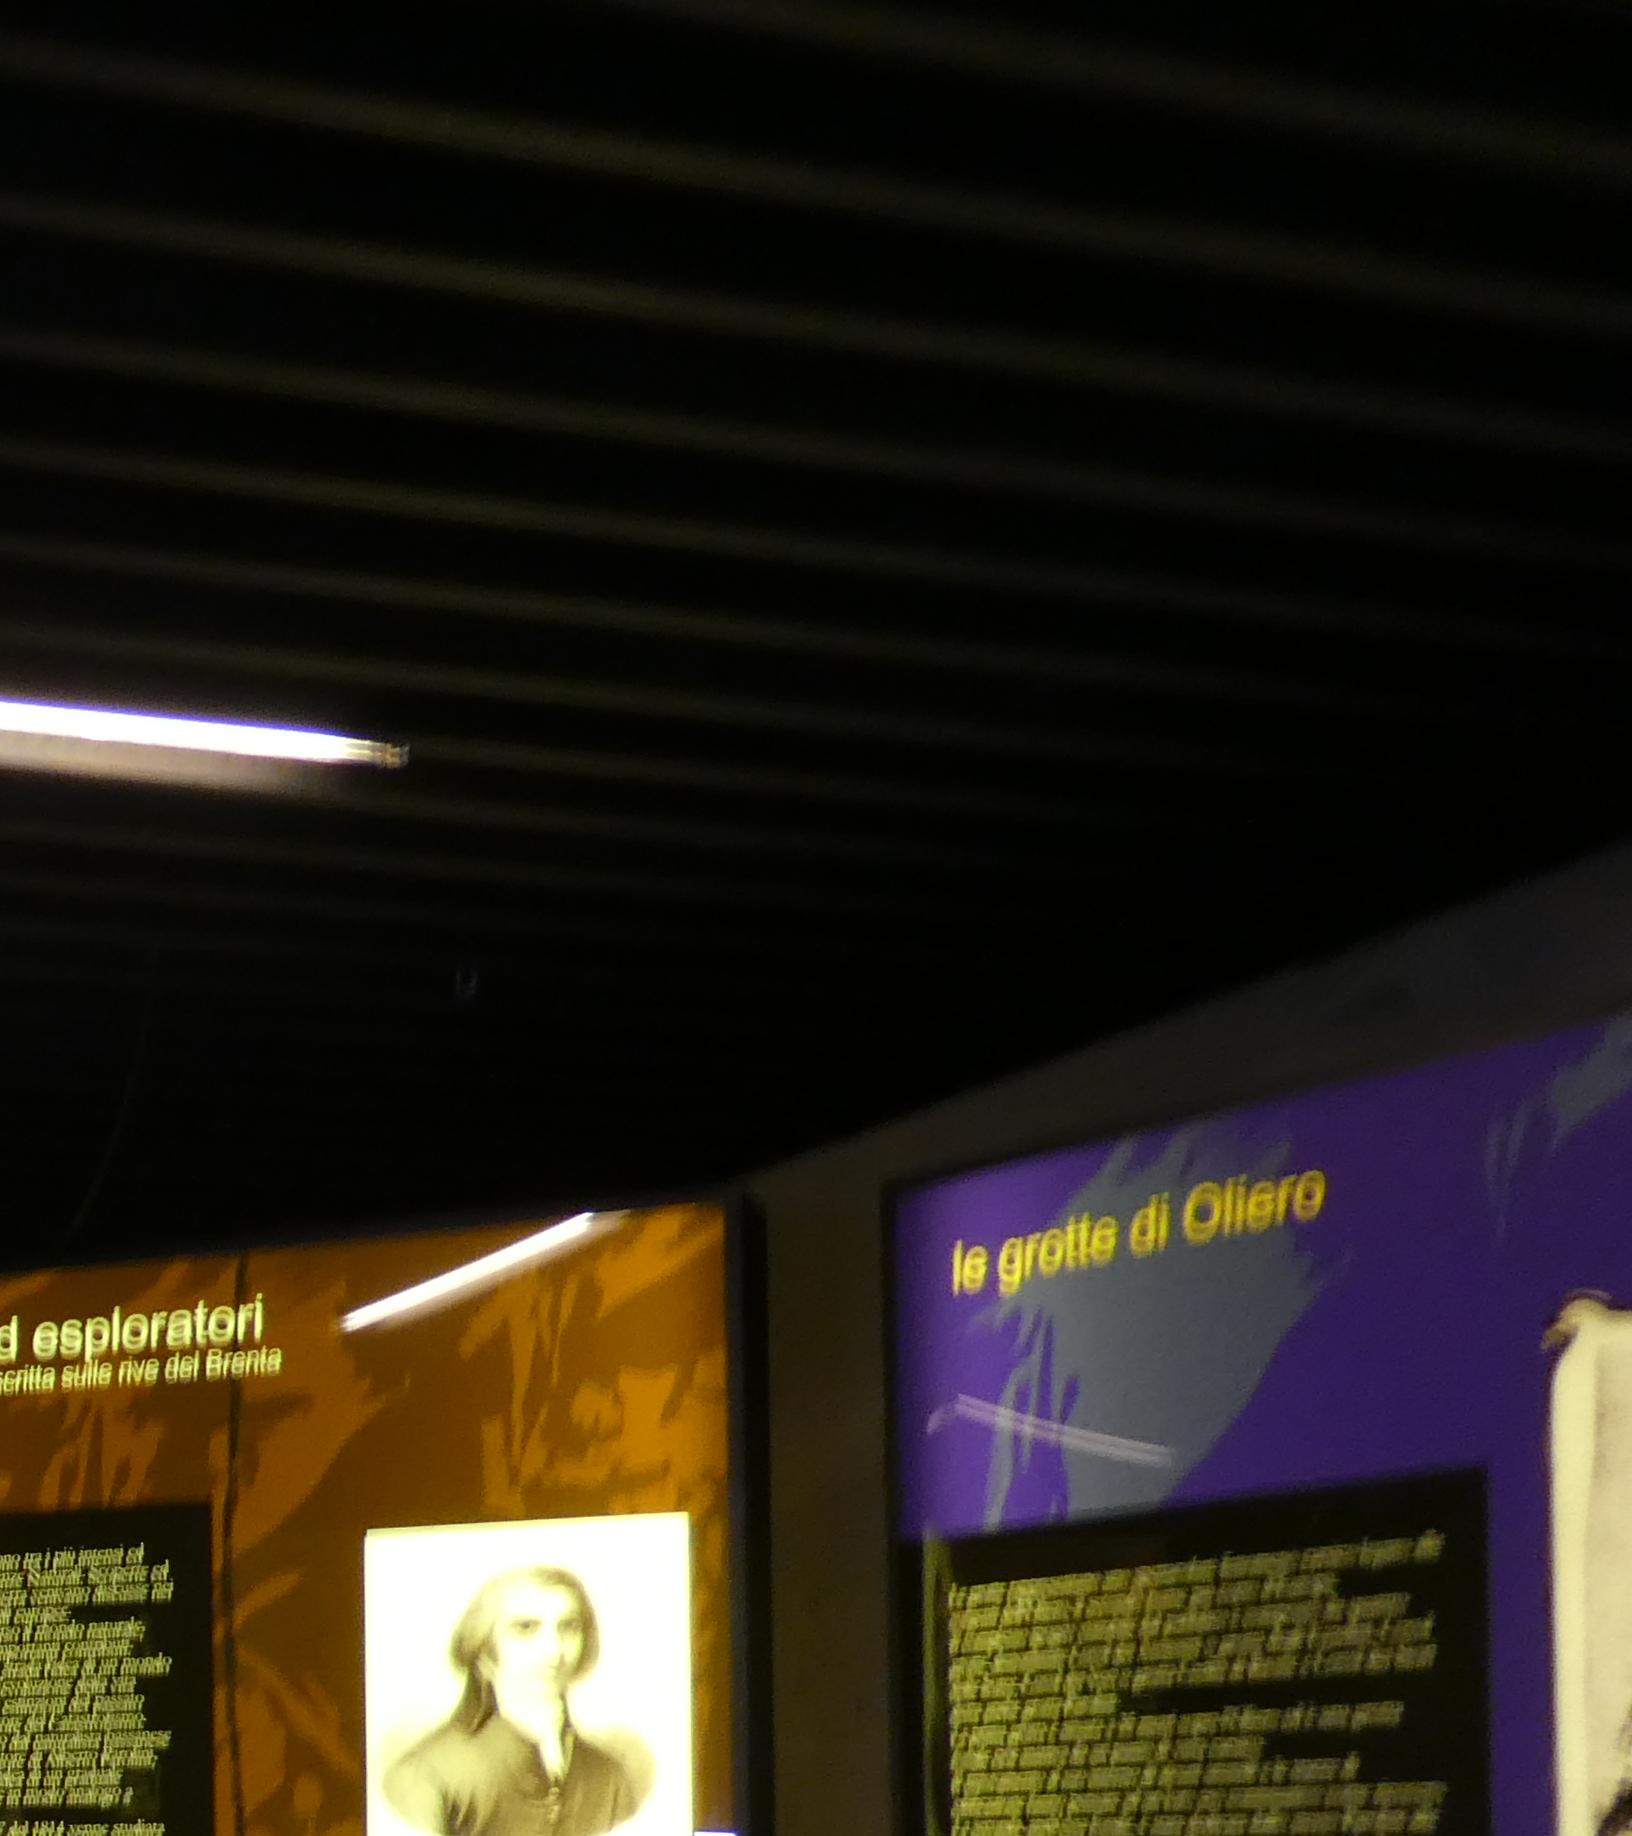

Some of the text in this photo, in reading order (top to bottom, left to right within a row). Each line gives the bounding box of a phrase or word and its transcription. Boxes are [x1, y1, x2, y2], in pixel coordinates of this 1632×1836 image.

[952, 1169, 1325, 1297] le grotte di Oliero
[33, 1294, 264, 1362] esploratori
[164, 1352, 200, 1384] del
[206, 1345, 282, 1381] Brenta
